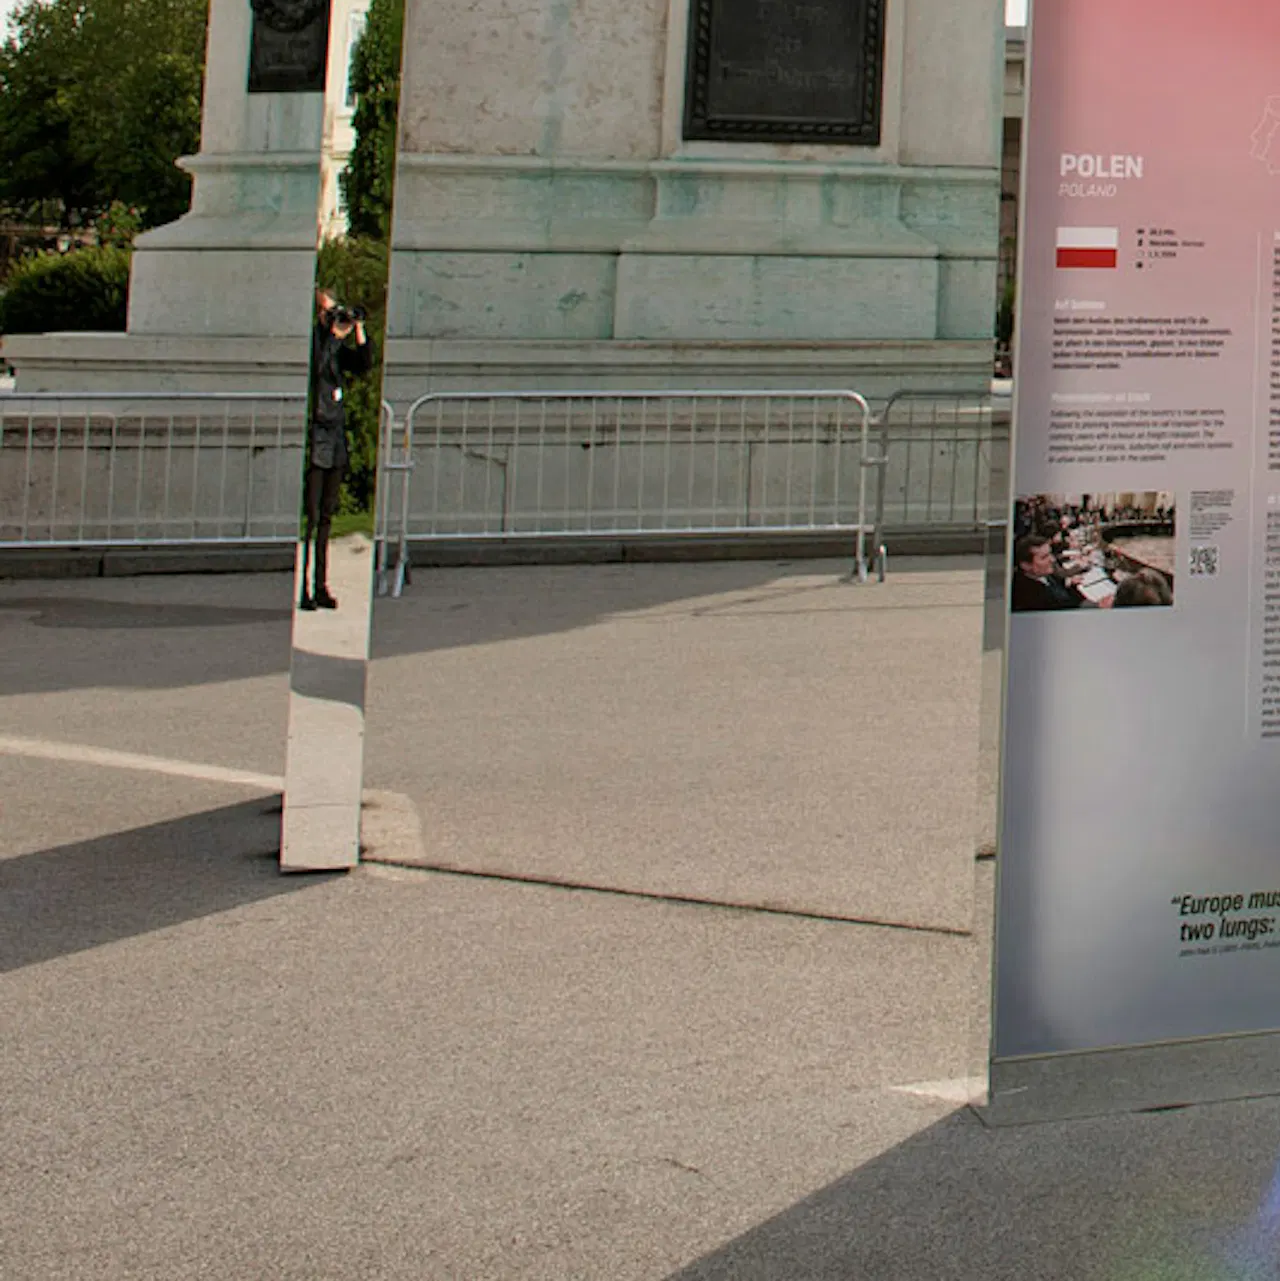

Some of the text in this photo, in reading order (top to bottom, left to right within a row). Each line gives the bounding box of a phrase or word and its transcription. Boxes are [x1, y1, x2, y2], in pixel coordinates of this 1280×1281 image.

[1059, 154, 1143, 179] POLEN
[1058, 183, 1117, 198] POLAND
[1171, 893, 1244, 918] “Europe
[1180, 921, 1214, 943] two
[1219, 917, 1276, 942] lungs:
